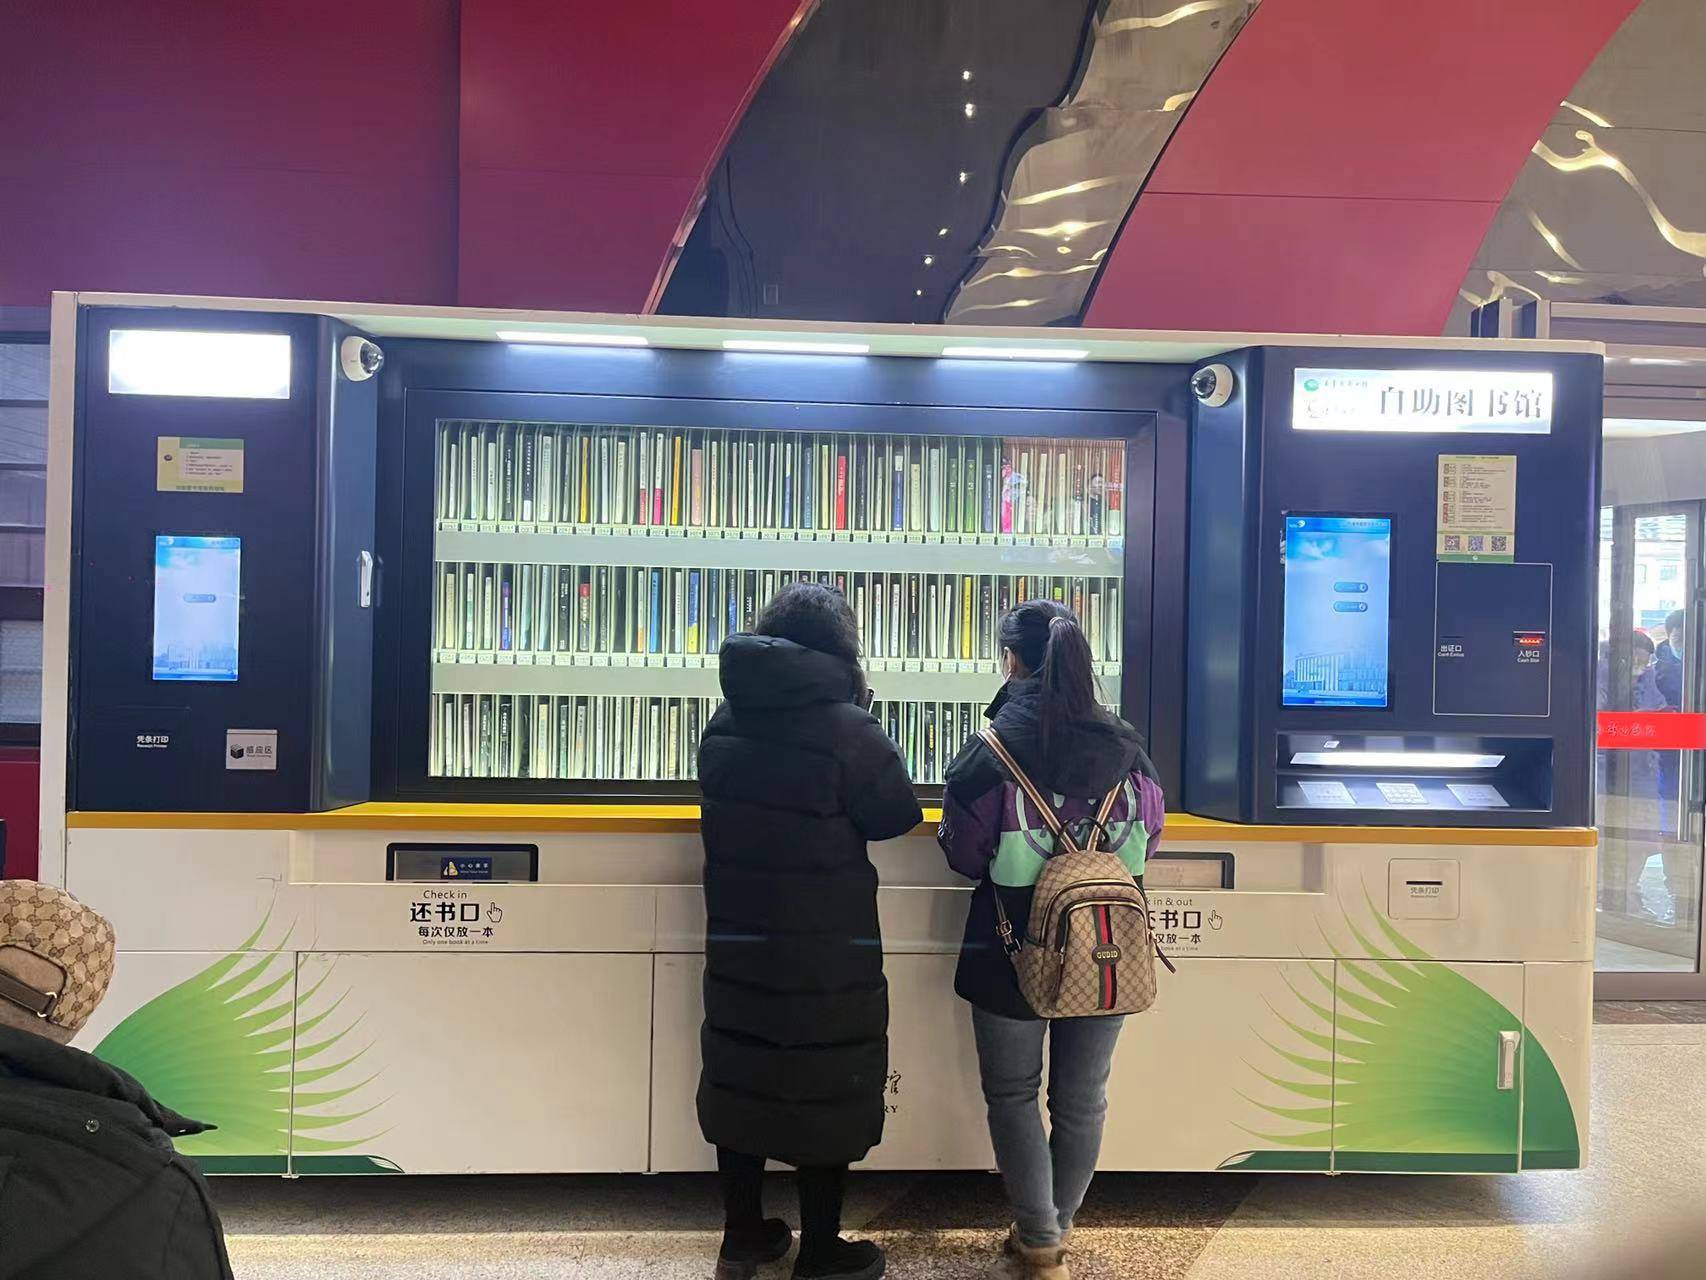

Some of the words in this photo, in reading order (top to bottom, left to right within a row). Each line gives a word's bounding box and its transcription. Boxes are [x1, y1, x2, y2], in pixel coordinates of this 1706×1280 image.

[1380, 386, 1542, 418] 自助图书馆
[1517, 650, 1540, 658] 入钞口
[423, 890, 455, 899] Check
[457, 890, 467, 899] in
[1165, 897, 1174, 906] &
[1176, 898, 1193, 906] out
[410, 902, 480, 922] 还书口
[418, 926, 494, 938] 每次仅放一本
